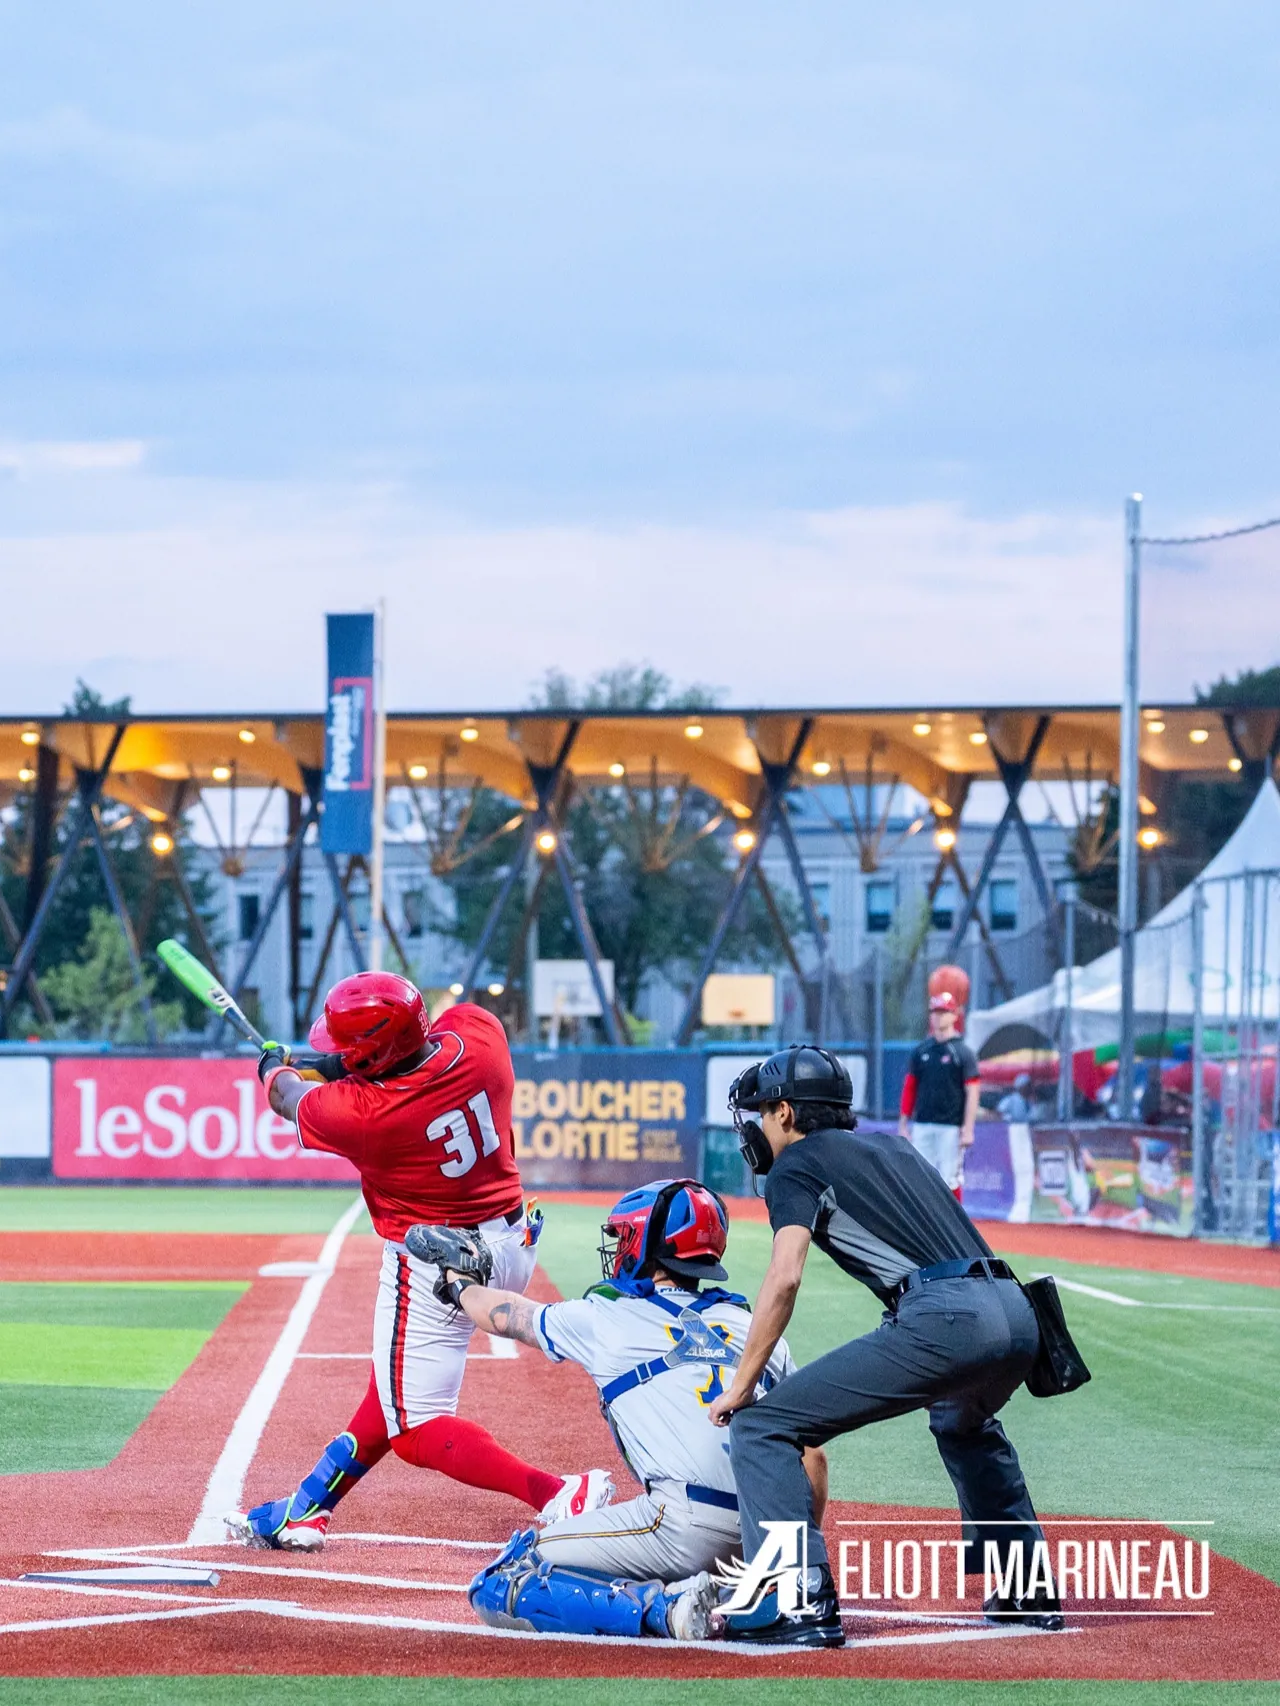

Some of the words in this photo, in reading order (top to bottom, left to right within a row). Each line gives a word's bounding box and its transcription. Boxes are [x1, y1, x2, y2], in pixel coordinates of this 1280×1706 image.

[75, 1078, 342, 1160] leSole
[514, 1079, 687, 1121] BOUCHER
[426, 1090, 502, 1178] 31
[514, 1120, 640, 1161] LORTIE
